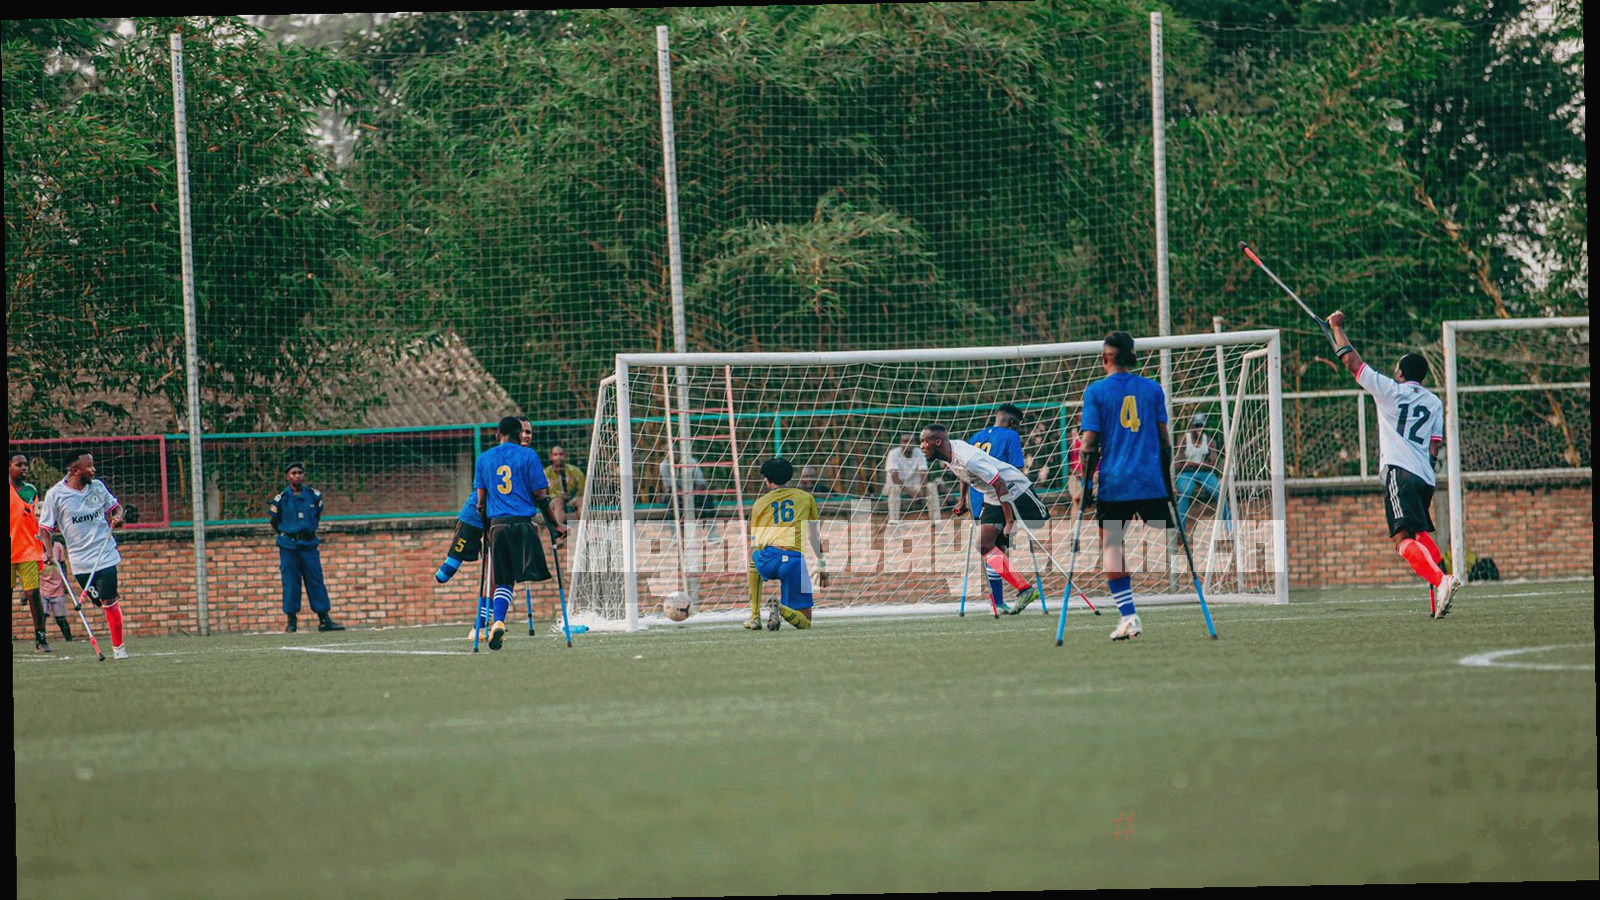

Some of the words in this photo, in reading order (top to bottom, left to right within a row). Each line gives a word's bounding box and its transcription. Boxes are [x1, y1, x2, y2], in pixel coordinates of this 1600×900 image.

[1120, 395, 1140, 432] 4
[1396, 403, 1431, 445] 12
[496, 465, 512, 494] 3
[72, 511, 98, 524] Kenya
[771, 499, 794, 524] 16
[454, 538, 467, 552] 5
[88, 586, 98, 598] 8
